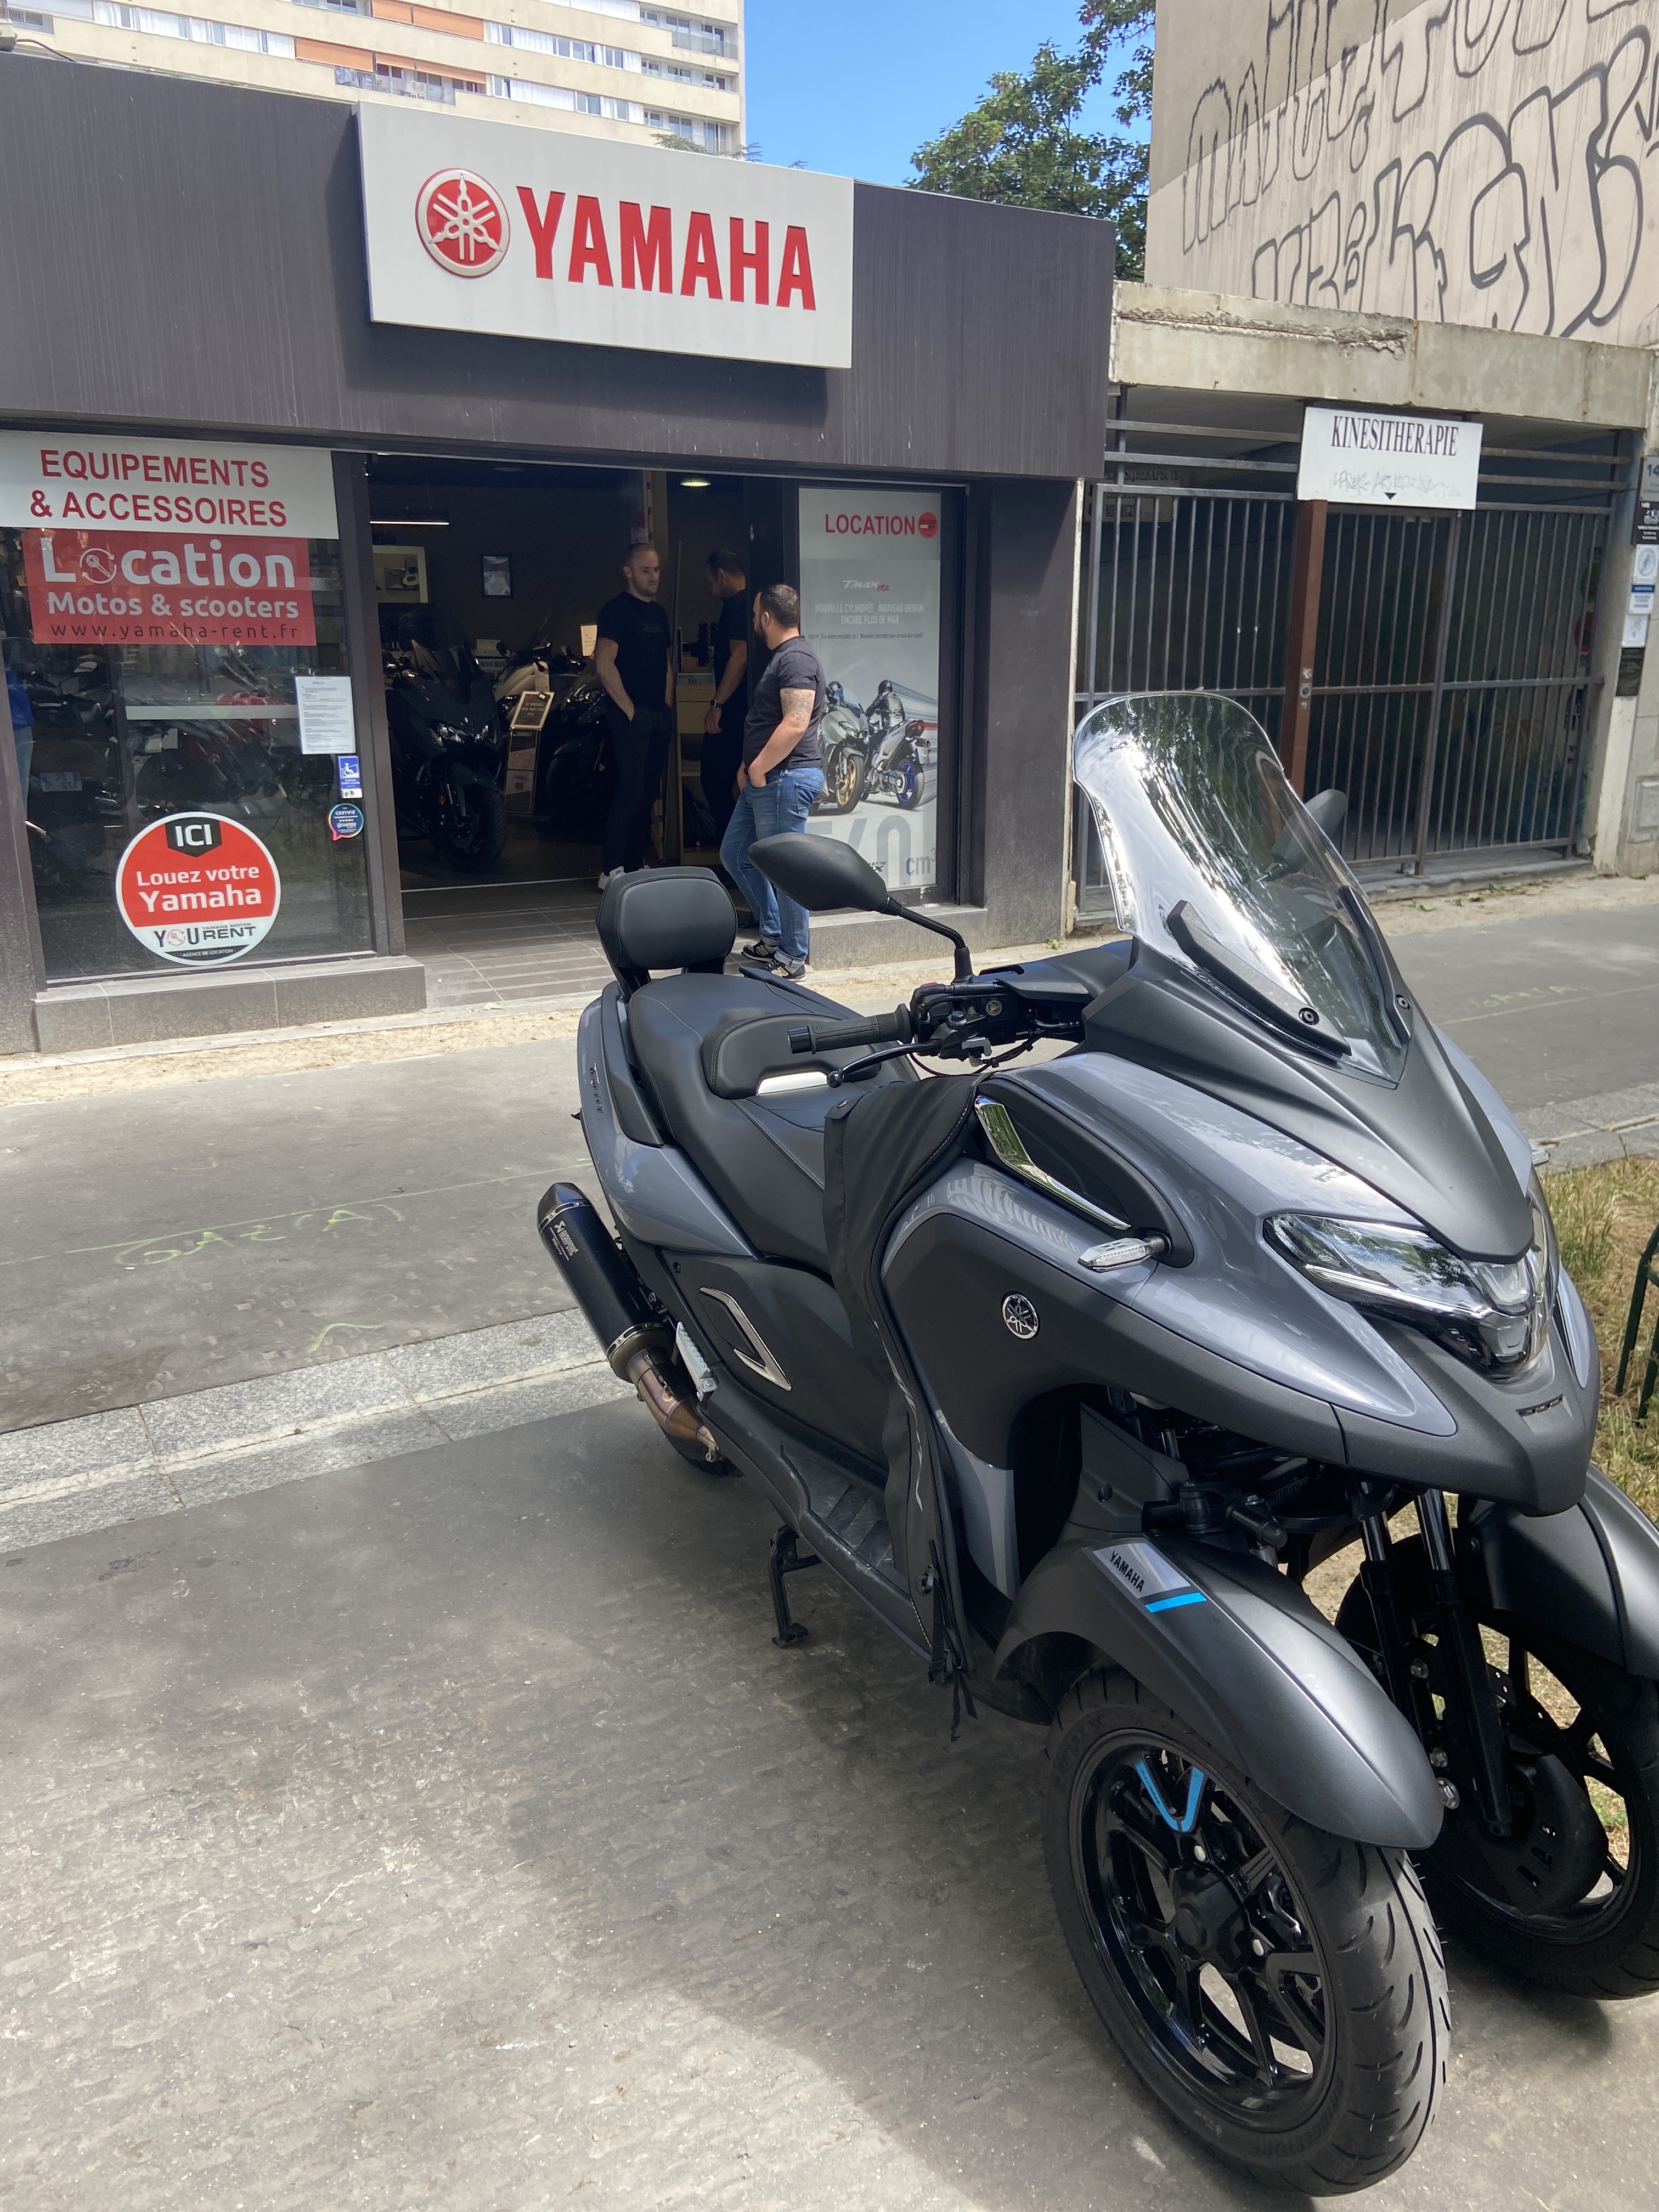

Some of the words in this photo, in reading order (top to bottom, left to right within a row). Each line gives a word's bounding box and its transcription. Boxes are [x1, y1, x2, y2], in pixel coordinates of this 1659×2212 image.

[515, 185, 817, 312] YAMAHA
[1330, 415, 1459, 456] KINESITHERAPIE
[40, 448, 269, 488] EQUIPEMENTS
[30, 489, 52, 518] &
[62, 492, 287, 527] ACCESSOIRES
[825, 514, 915, 535] LOCATION
[48, 591, 142, 616] Motos
[151, 592, 172, 617] &
[180, 596, 300, 619] scooters
[864, 615, 878, 624] PLUS
[887, 614, 900, 624] MAX
[51, 623, 298, 640] www.yamaha-rent.fr
[174, 823, 213, 847] ICI
[135, 870, 201, 887] Louez
[205, 865, 260, 882] votre
[138, 884, 262, 913] Yamaha
[202, 926, 257, 940] RENT
[1109, 1550, 1145, 1593] YAMAHA
